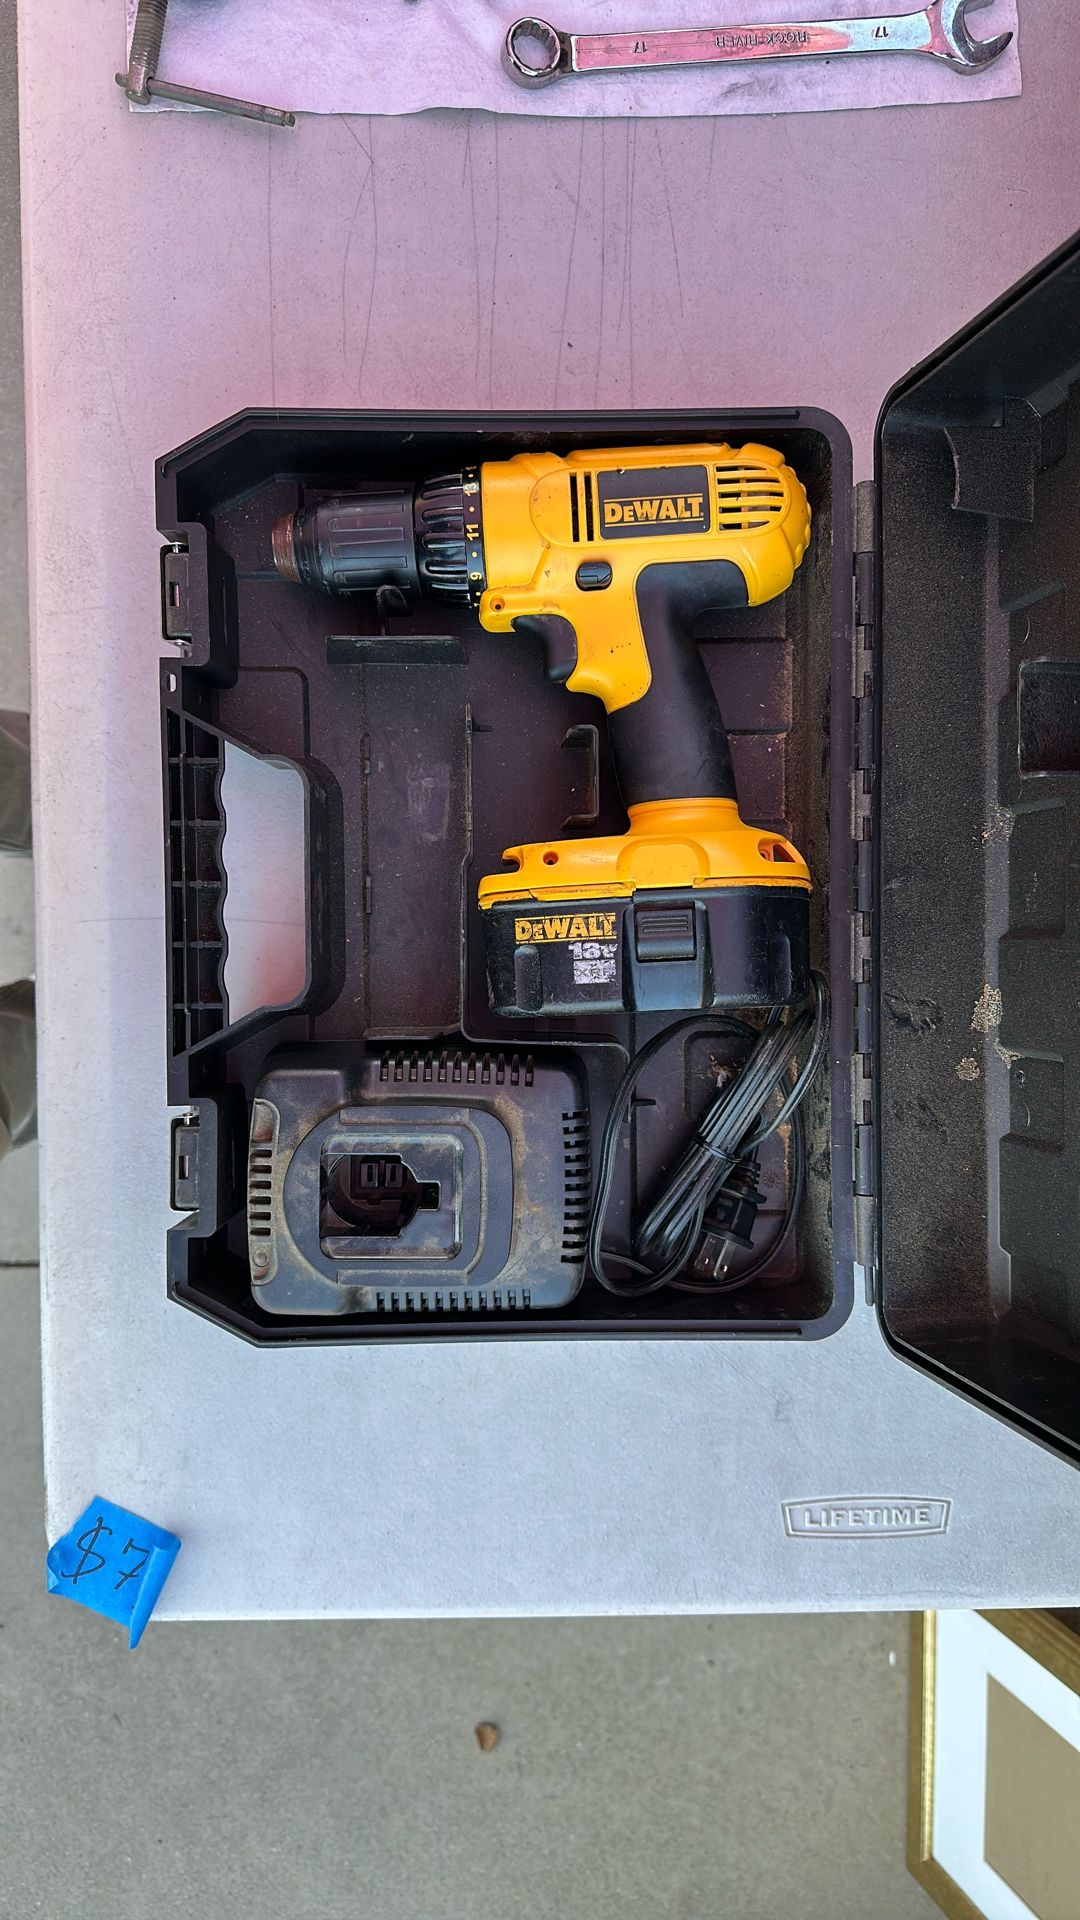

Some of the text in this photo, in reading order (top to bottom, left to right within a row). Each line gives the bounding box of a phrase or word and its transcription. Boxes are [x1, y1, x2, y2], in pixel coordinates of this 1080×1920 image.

[714, 31, 808, 48] ROCK RIVER
[873, 26, 889, 38] 17
[633, 41, 648, 53] 17
[463, 482, 479, 497] 13
[604, 497, 703, 523] DEWALT
[465, 523, 479, 541] 11
[470, 571, 483, 581] 9
[804, 1506, 931, 1527] LIFETIME
[61, 1517, 150, 1590] $7
